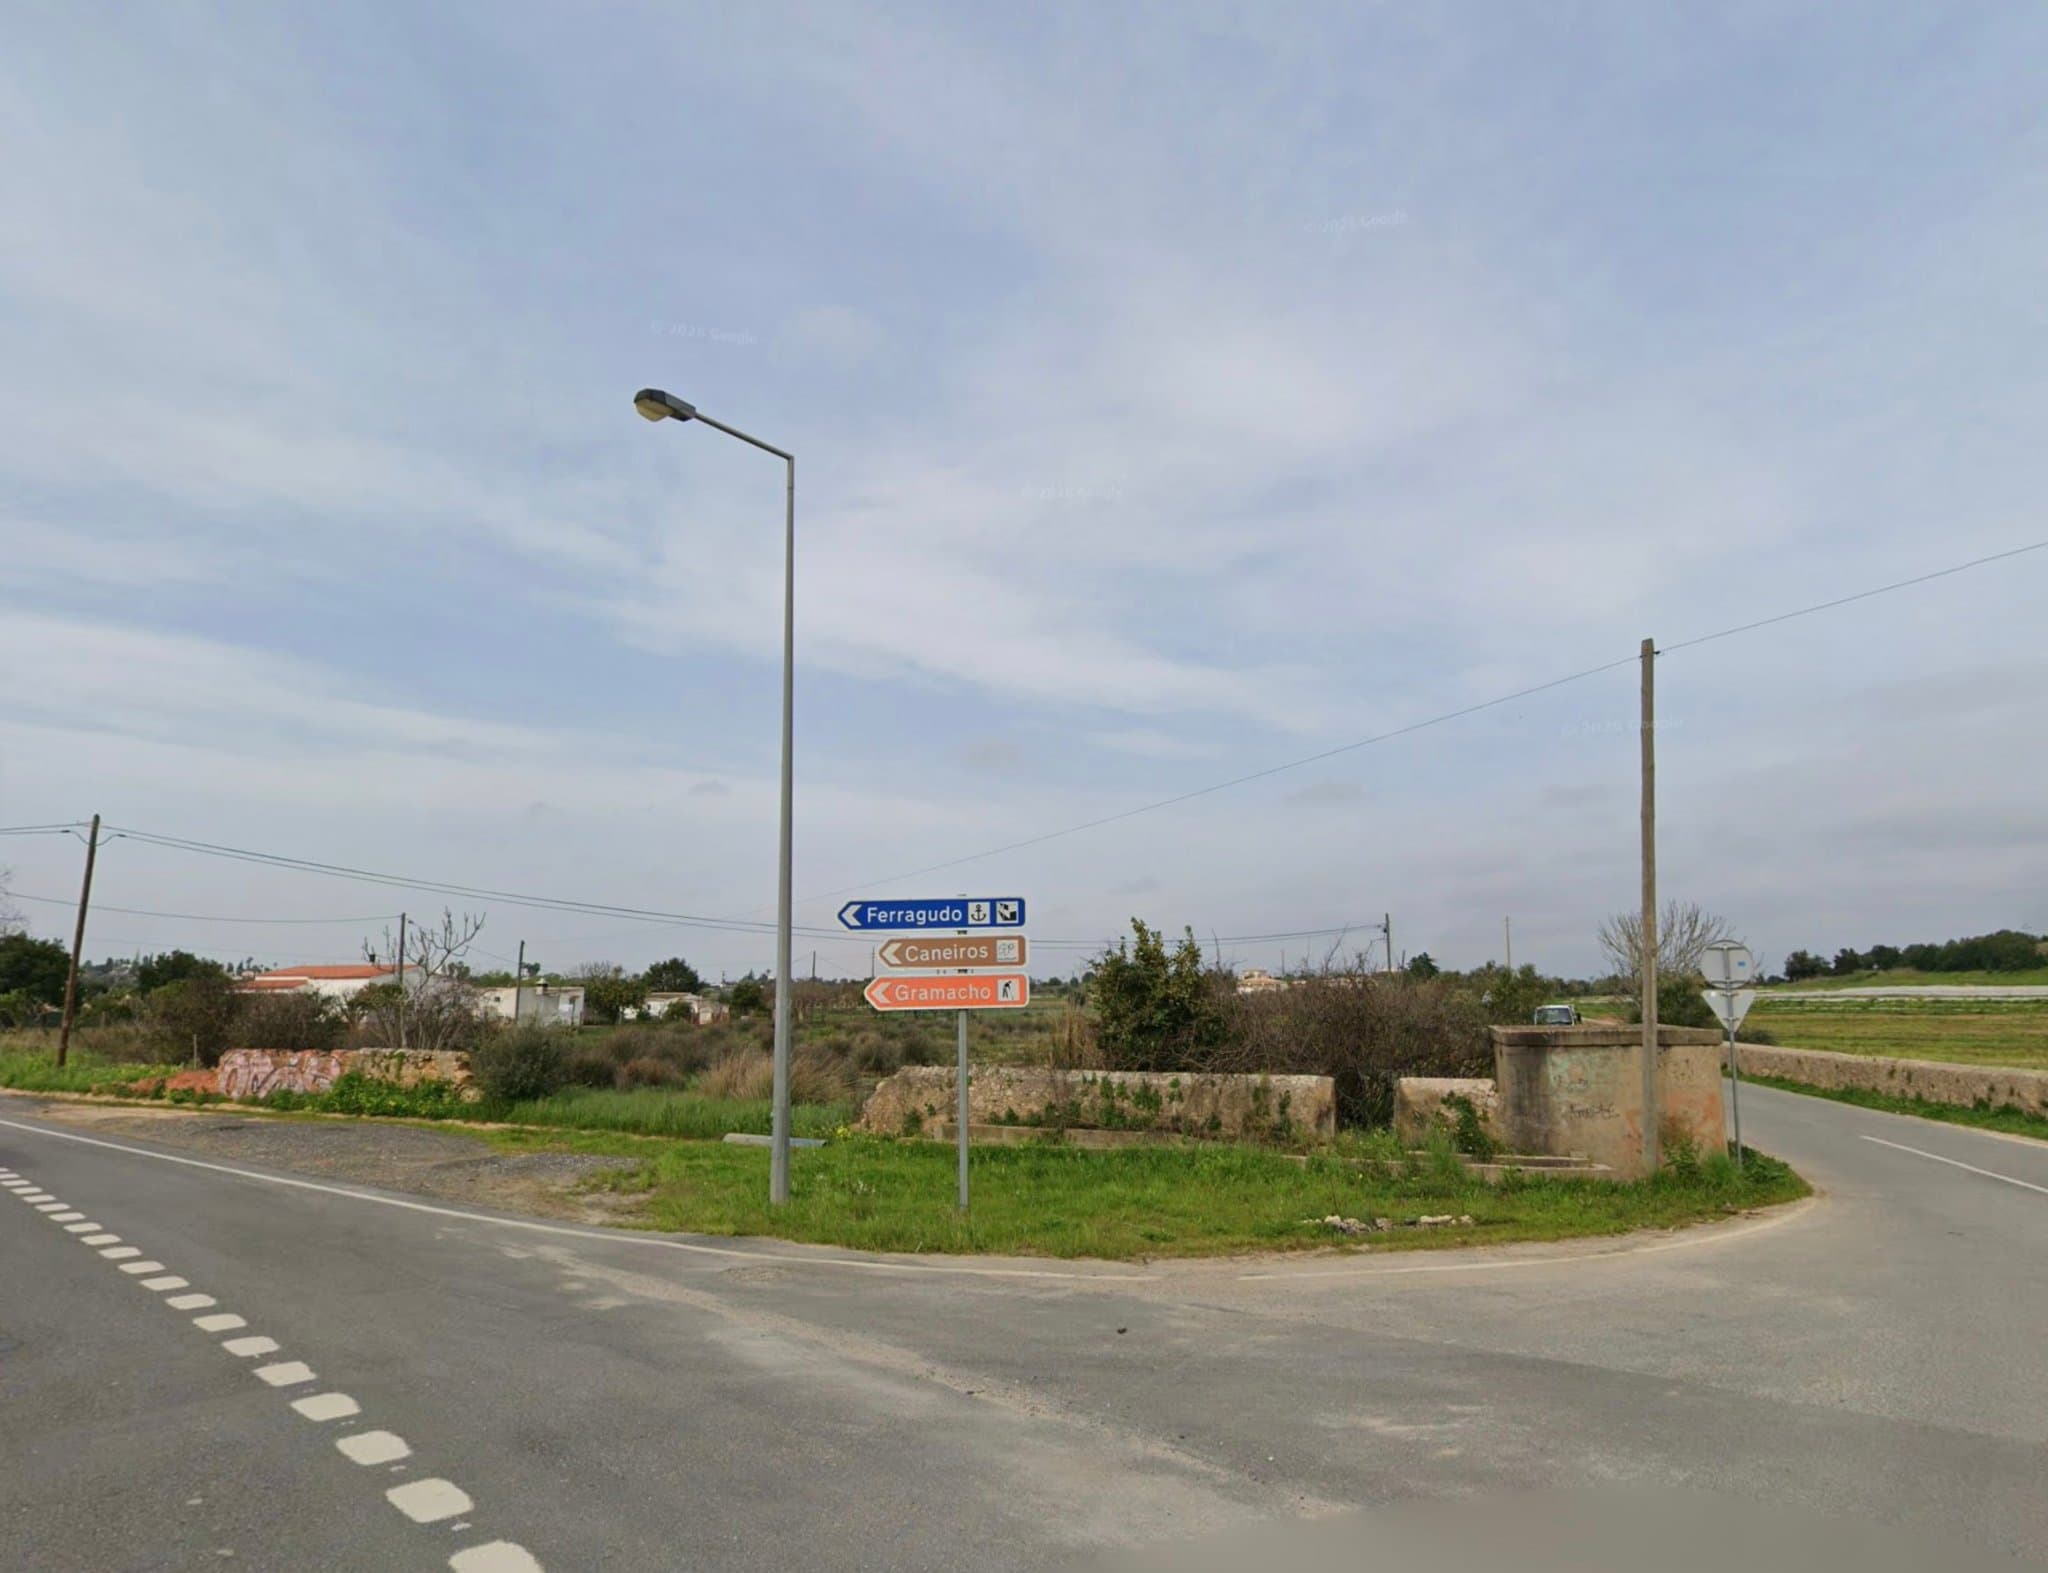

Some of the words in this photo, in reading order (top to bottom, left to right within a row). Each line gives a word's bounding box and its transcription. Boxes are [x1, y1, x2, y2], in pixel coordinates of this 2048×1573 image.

[867, 905, 962, 925] Ferragudo
[905, 943, 989, 962] Caneiros
[895, 983, 991, 1001] Gramacho
